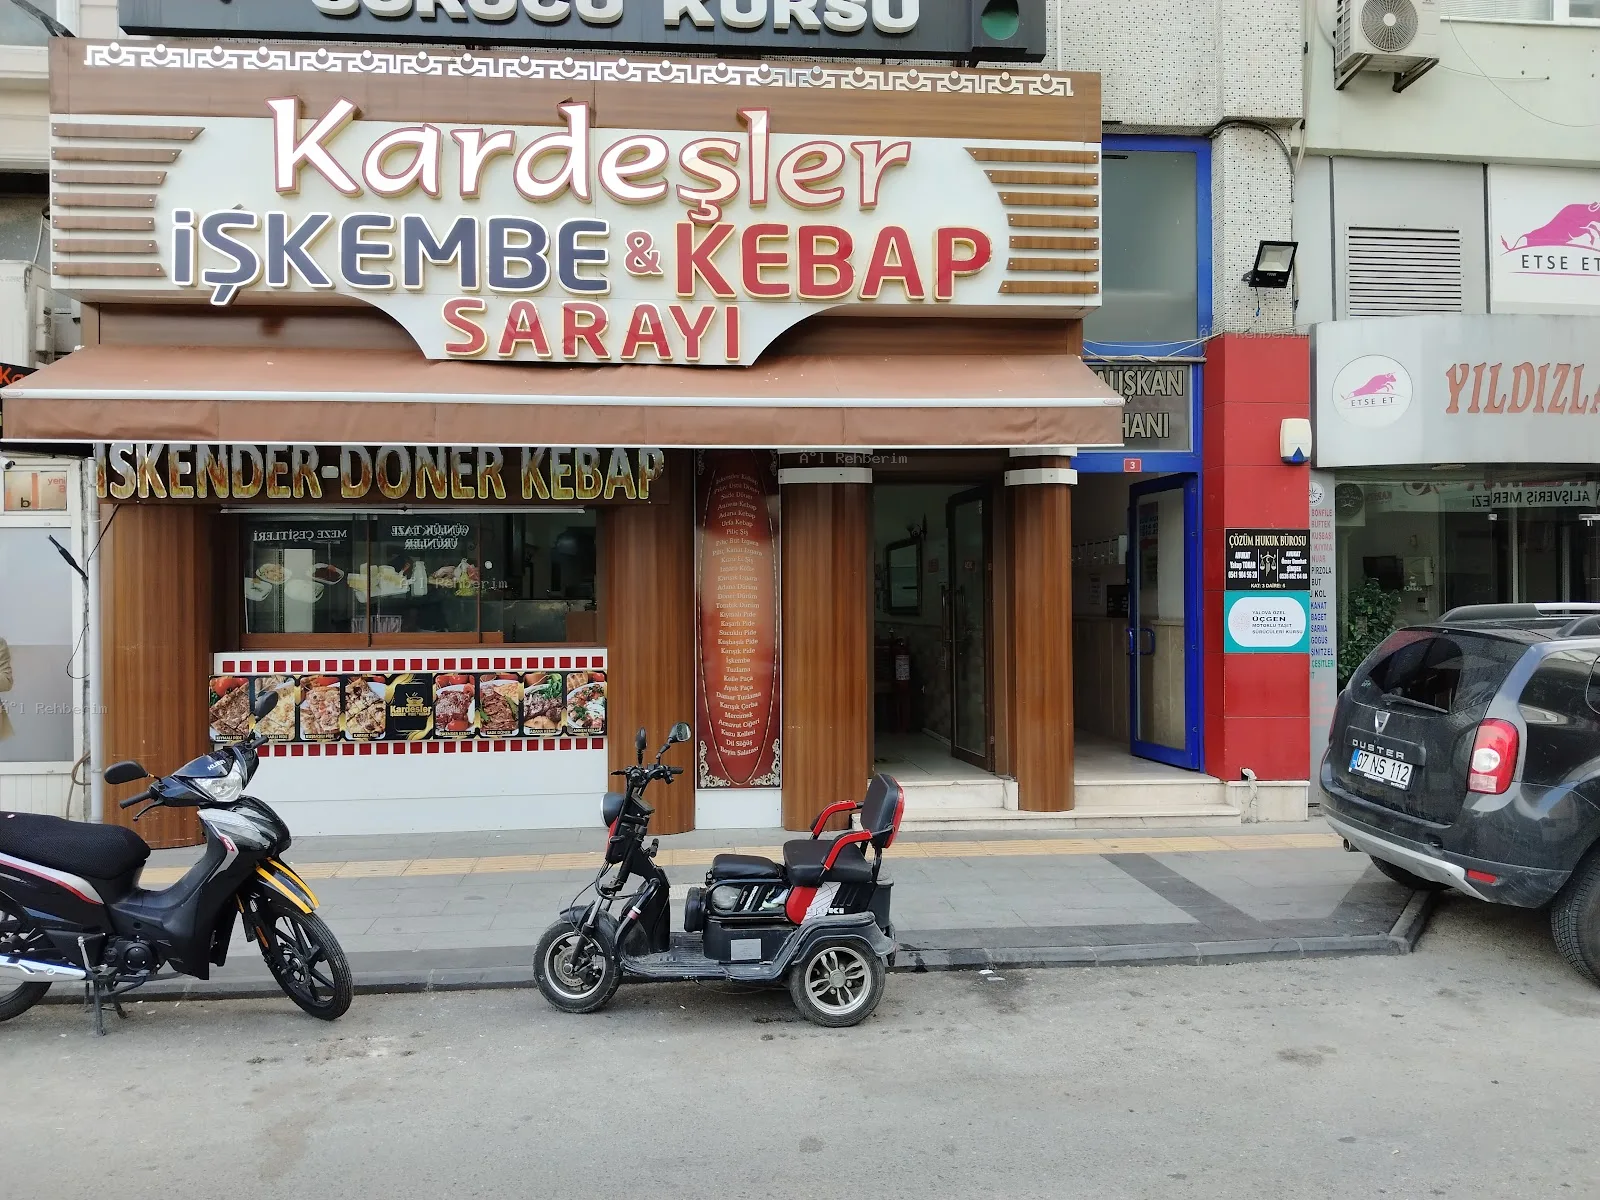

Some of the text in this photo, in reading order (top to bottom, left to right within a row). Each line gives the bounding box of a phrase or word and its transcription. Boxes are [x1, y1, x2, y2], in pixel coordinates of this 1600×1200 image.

[264, 95, 912, 225] Kardeşler
[171, 207, 993, 306] İŞKEMBE & KEBAP
[1522, 254, 1600, 272] ETSE ET
[441, 297, 741, 362] SARAYI
[1351, 397, 1395, 407] ETSE ET
[521, 446, 665, 500] KEBAP
[1129, 461, 1136, 470] 3
[1229, 533, 1307, 548] ÇÖZÜM HUKUK BÜROSU
[1311, 578, 1321, 586] BUT
[1314, 590, 1327, 598] KOL
[1311, 601, 1327, 609] KANAT
[1352, 739, 1404, 760] DUSTER
[1357, 752, 1369, 769] 07
[1370, 756, 1387, 775] NS
[1390, 762, 1410, 783] 112
